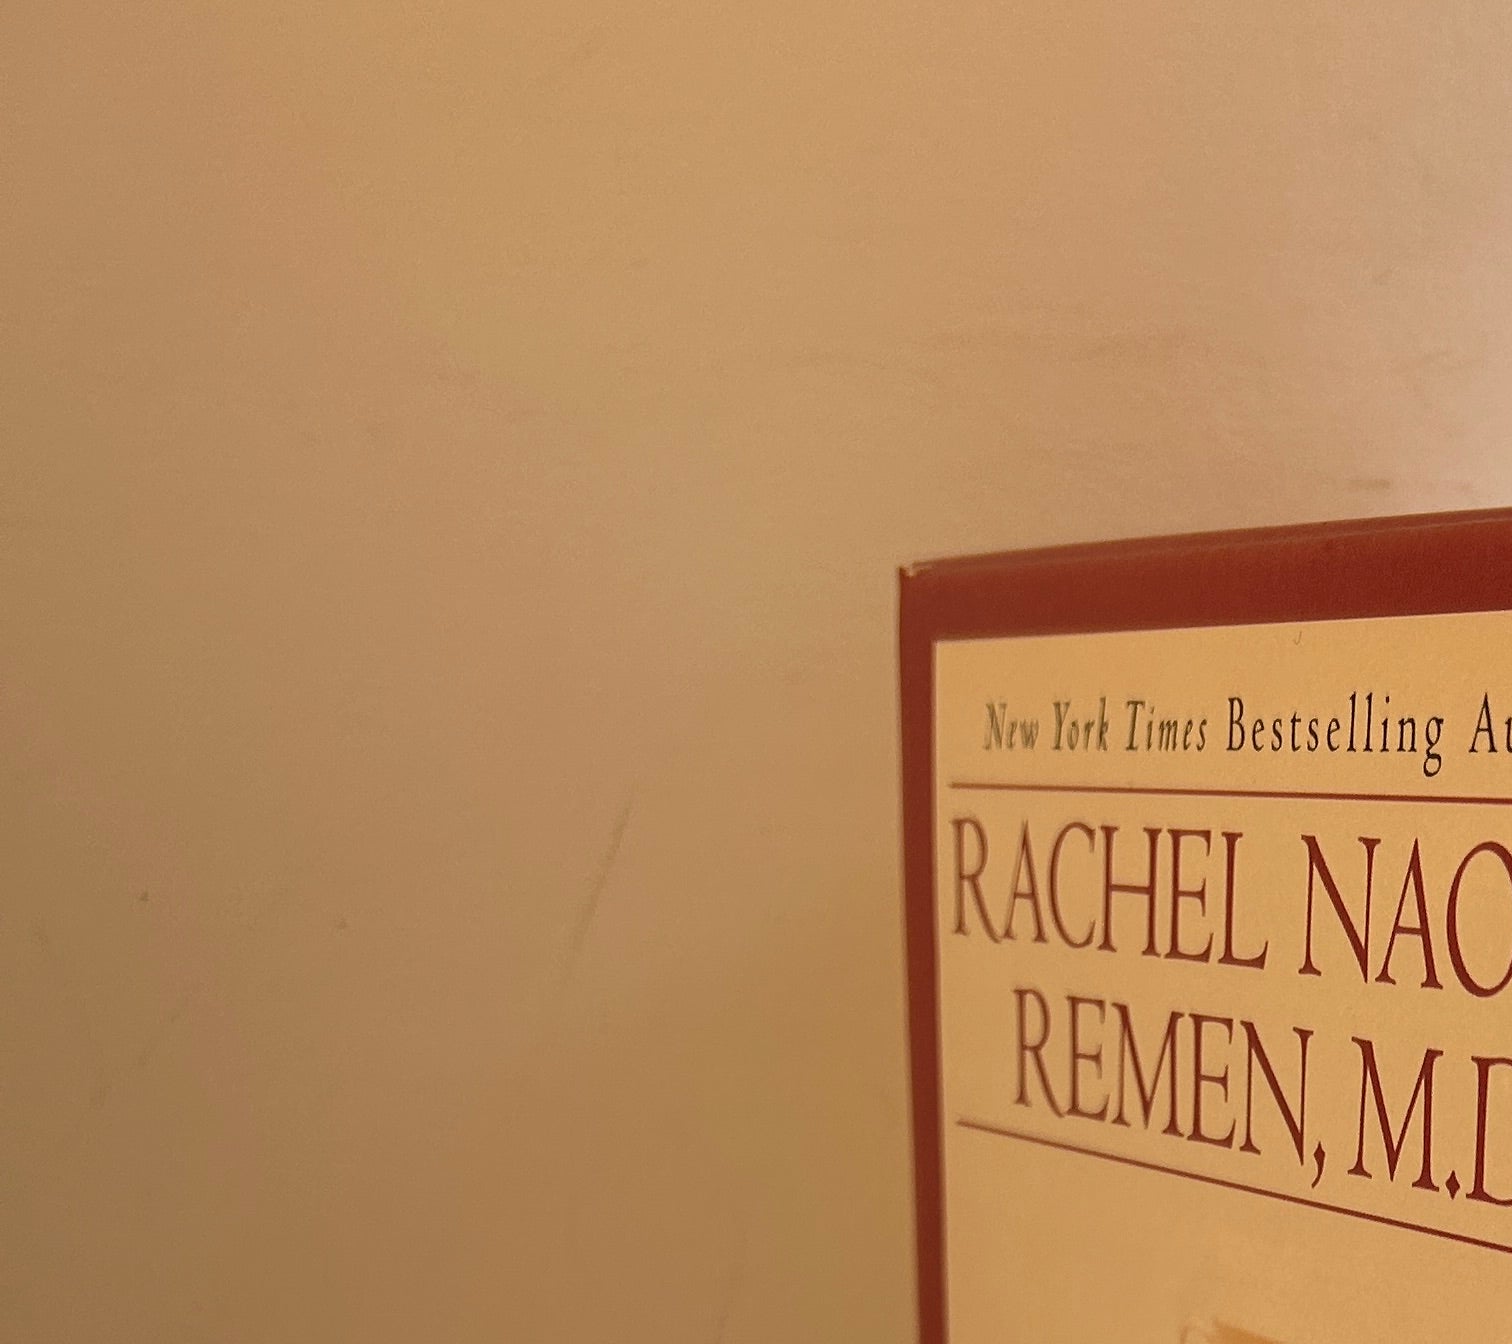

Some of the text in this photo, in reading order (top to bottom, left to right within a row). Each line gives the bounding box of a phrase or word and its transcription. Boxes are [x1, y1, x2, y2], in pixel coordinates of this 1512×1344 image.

[983, 702, 1039, 751] New
[1053, 698, 1110, 751] York
[1125, 701, 1208, 751] Times
[1226, 692, 1445, 777] Bestselling
[951, 817, 1268, 972] RACHEL
[1012, 988, 1326, 1188] REMEN,
